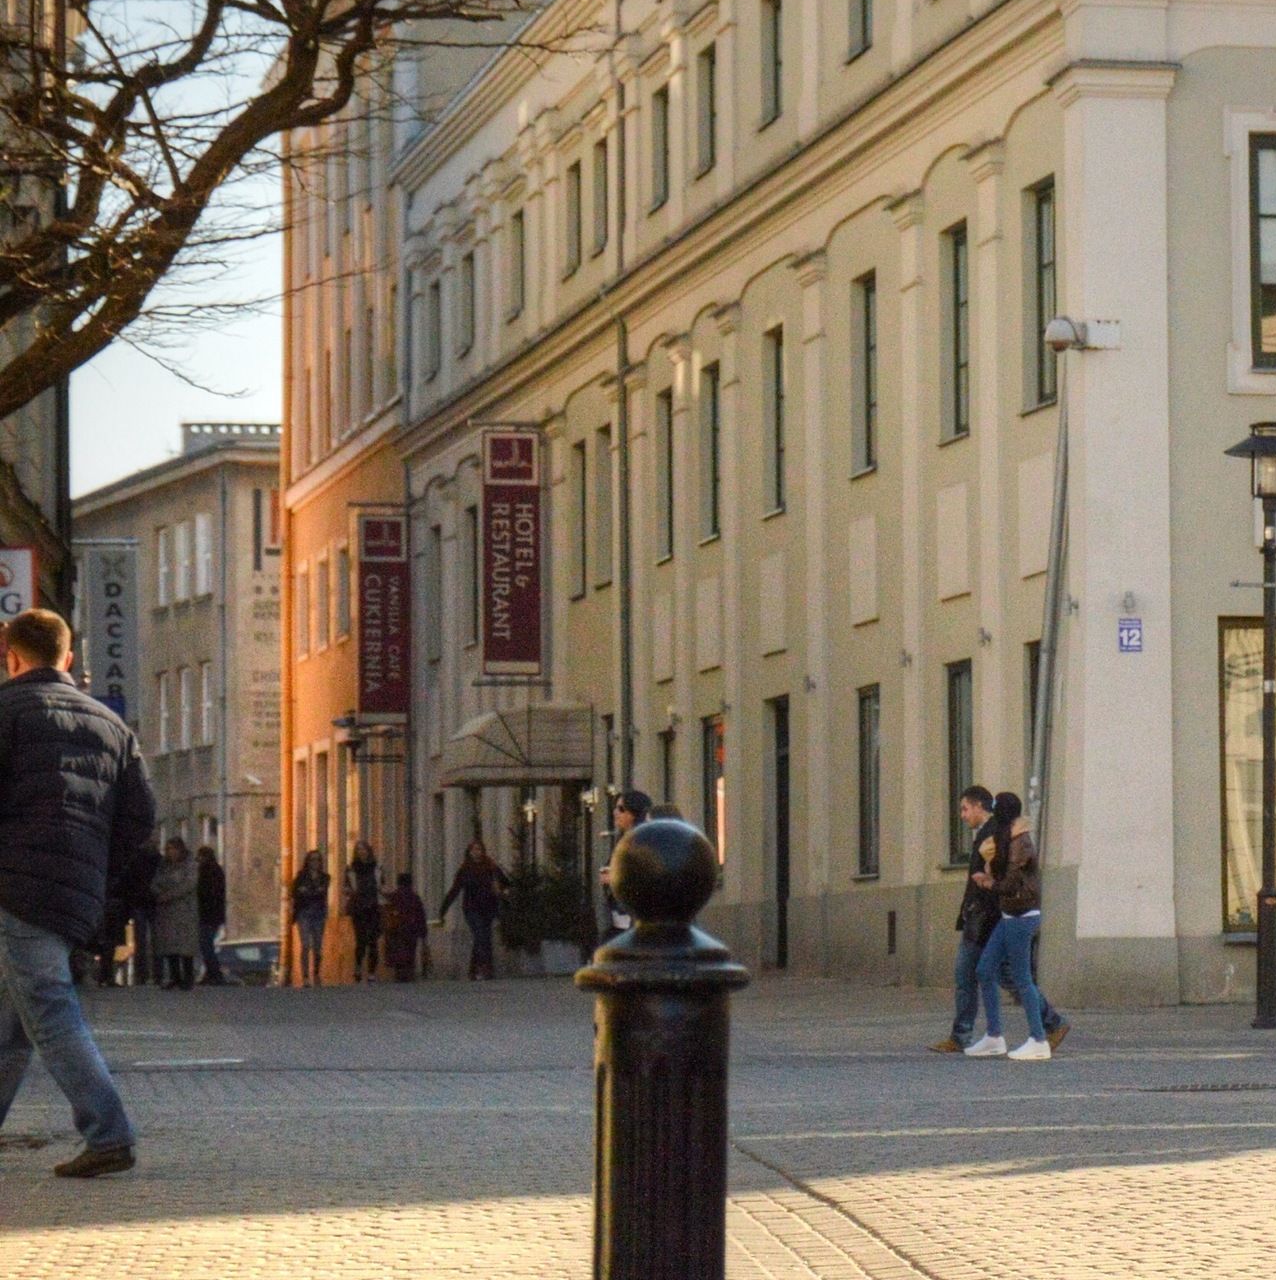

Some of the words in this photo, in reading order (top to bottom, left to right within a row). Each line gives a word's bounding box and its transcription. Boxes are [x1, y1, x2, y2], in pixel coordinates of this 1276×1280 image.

[514, 503, 534, 570] HOTEL
[491, 502, 511, 641] RESTAURANT
[514, 573, 531, 589] &
[364, 574, 383, 693] CUKIERNIA
[1119, 628, 1141, 646] 12
